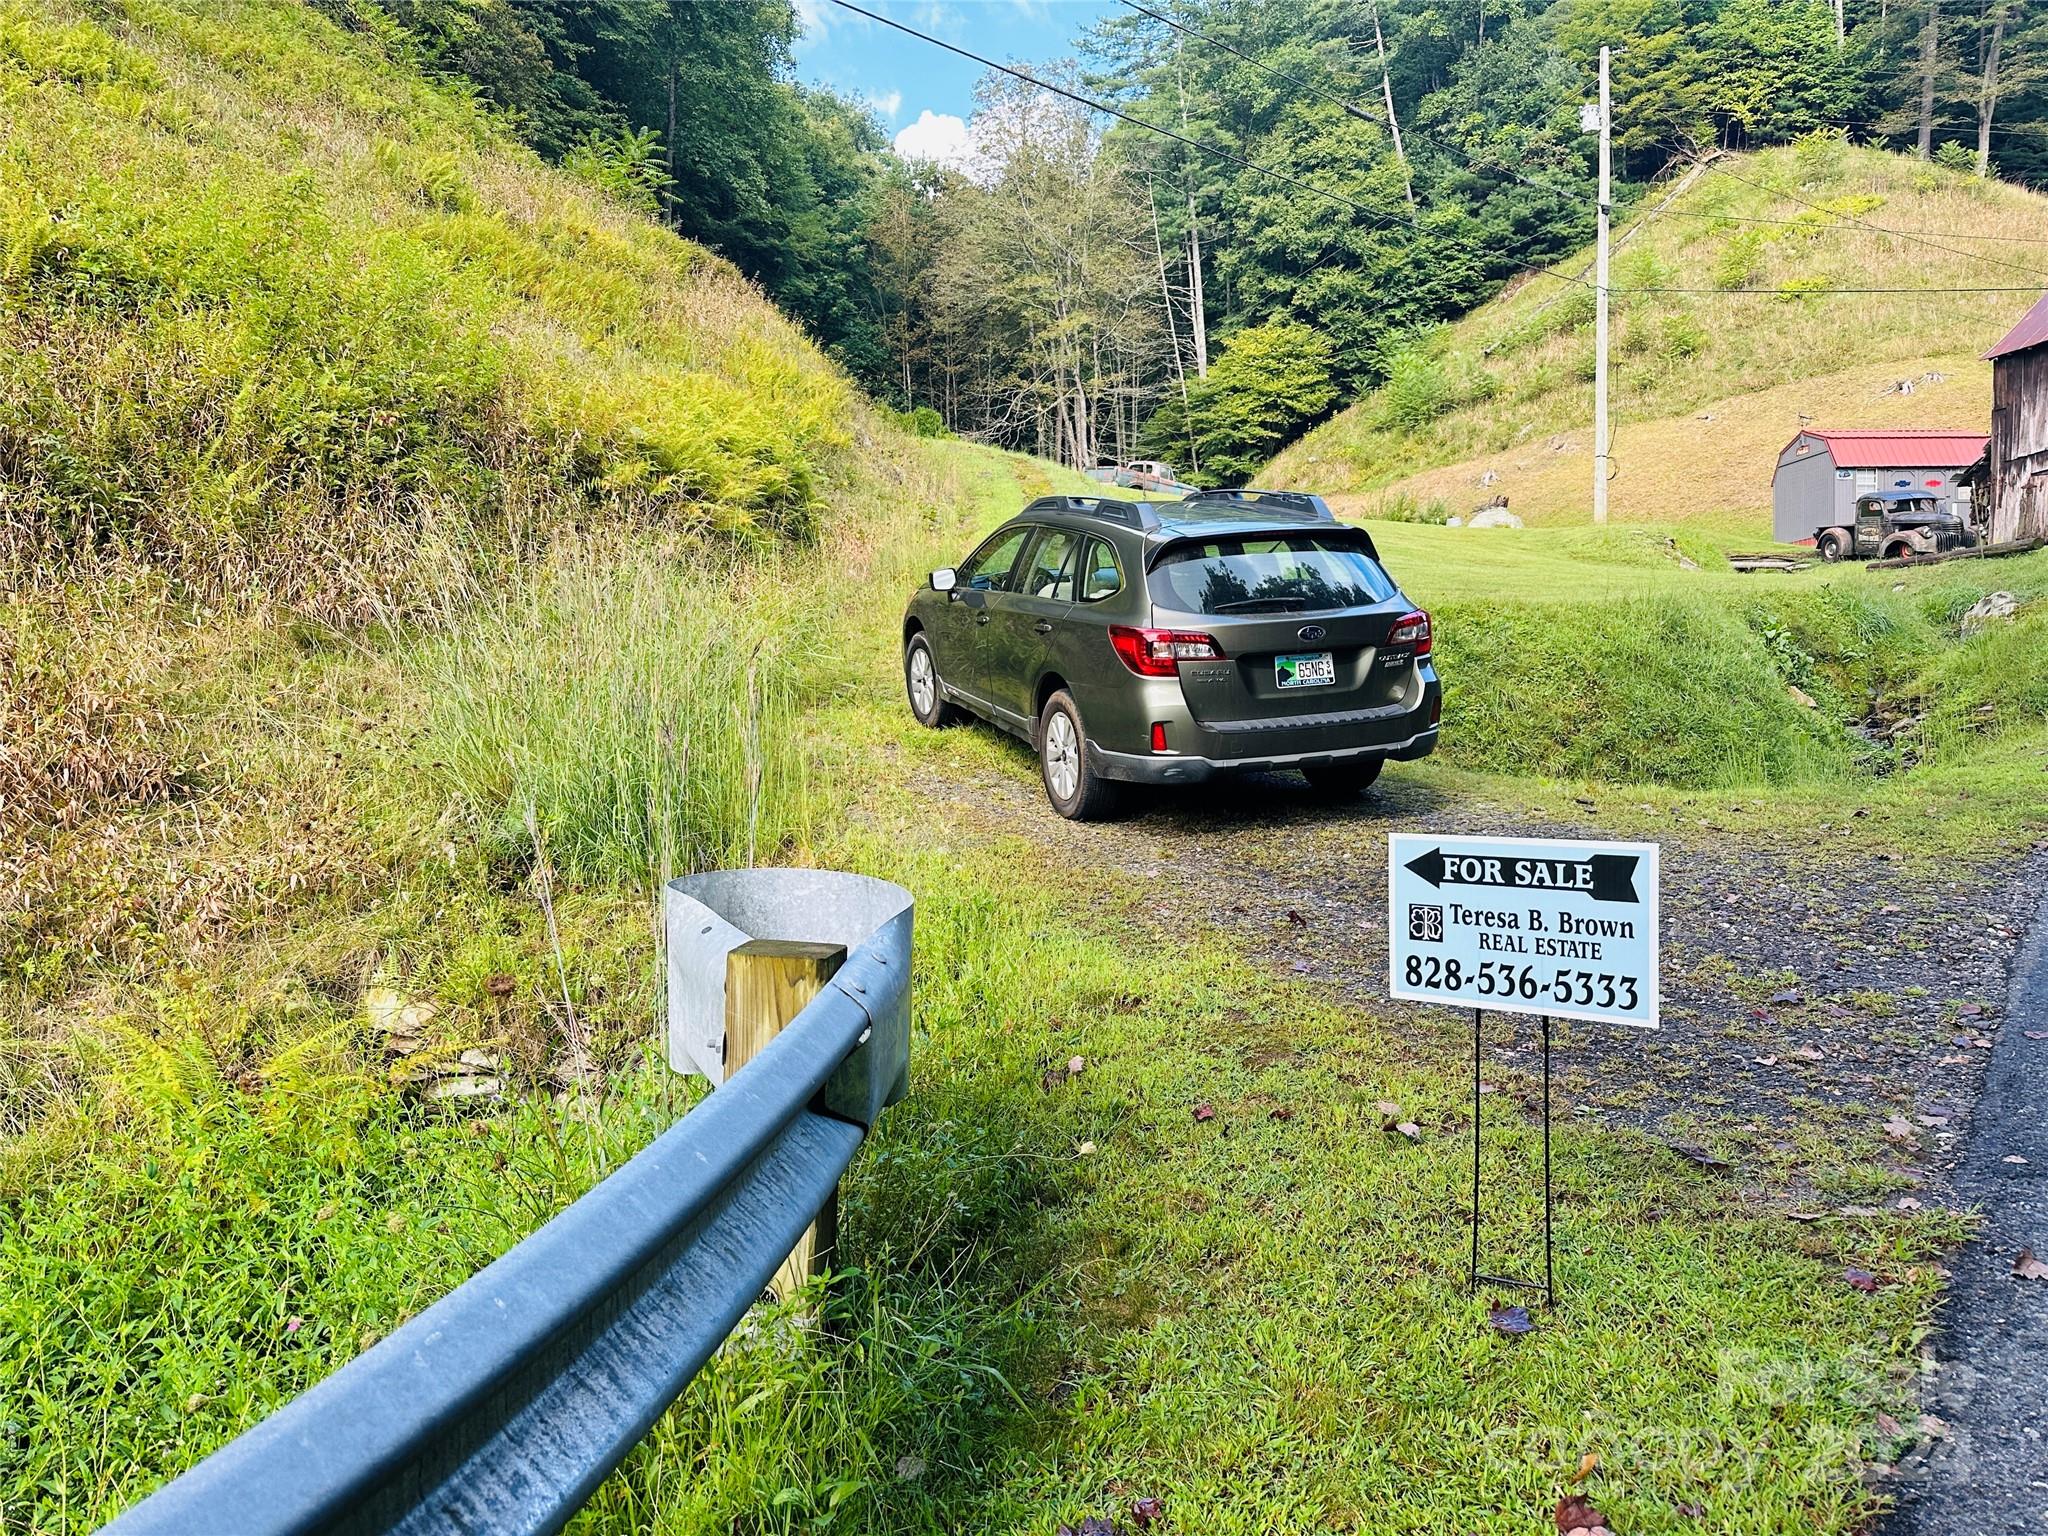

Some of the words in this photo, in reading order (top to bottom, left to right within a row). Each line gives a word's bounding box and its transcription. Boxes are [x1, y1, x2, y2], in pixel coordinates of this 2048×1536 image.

[1298, 661, 1325, 678] 65N6
[1442, 857, 1505, 884] FOR
[1514, 860, 1594, 890] SALE
[1449, 903, 1520, 930] Teresa
[1528, 909, 1549, 932] B.
[1558, 911, 1635, 939] Brown
[1479, 932, 1528, 954] REAL
[1535, 937, 1602, 960] ESTATE
[1405, 954, 1639, 1011] 828-536-5333
